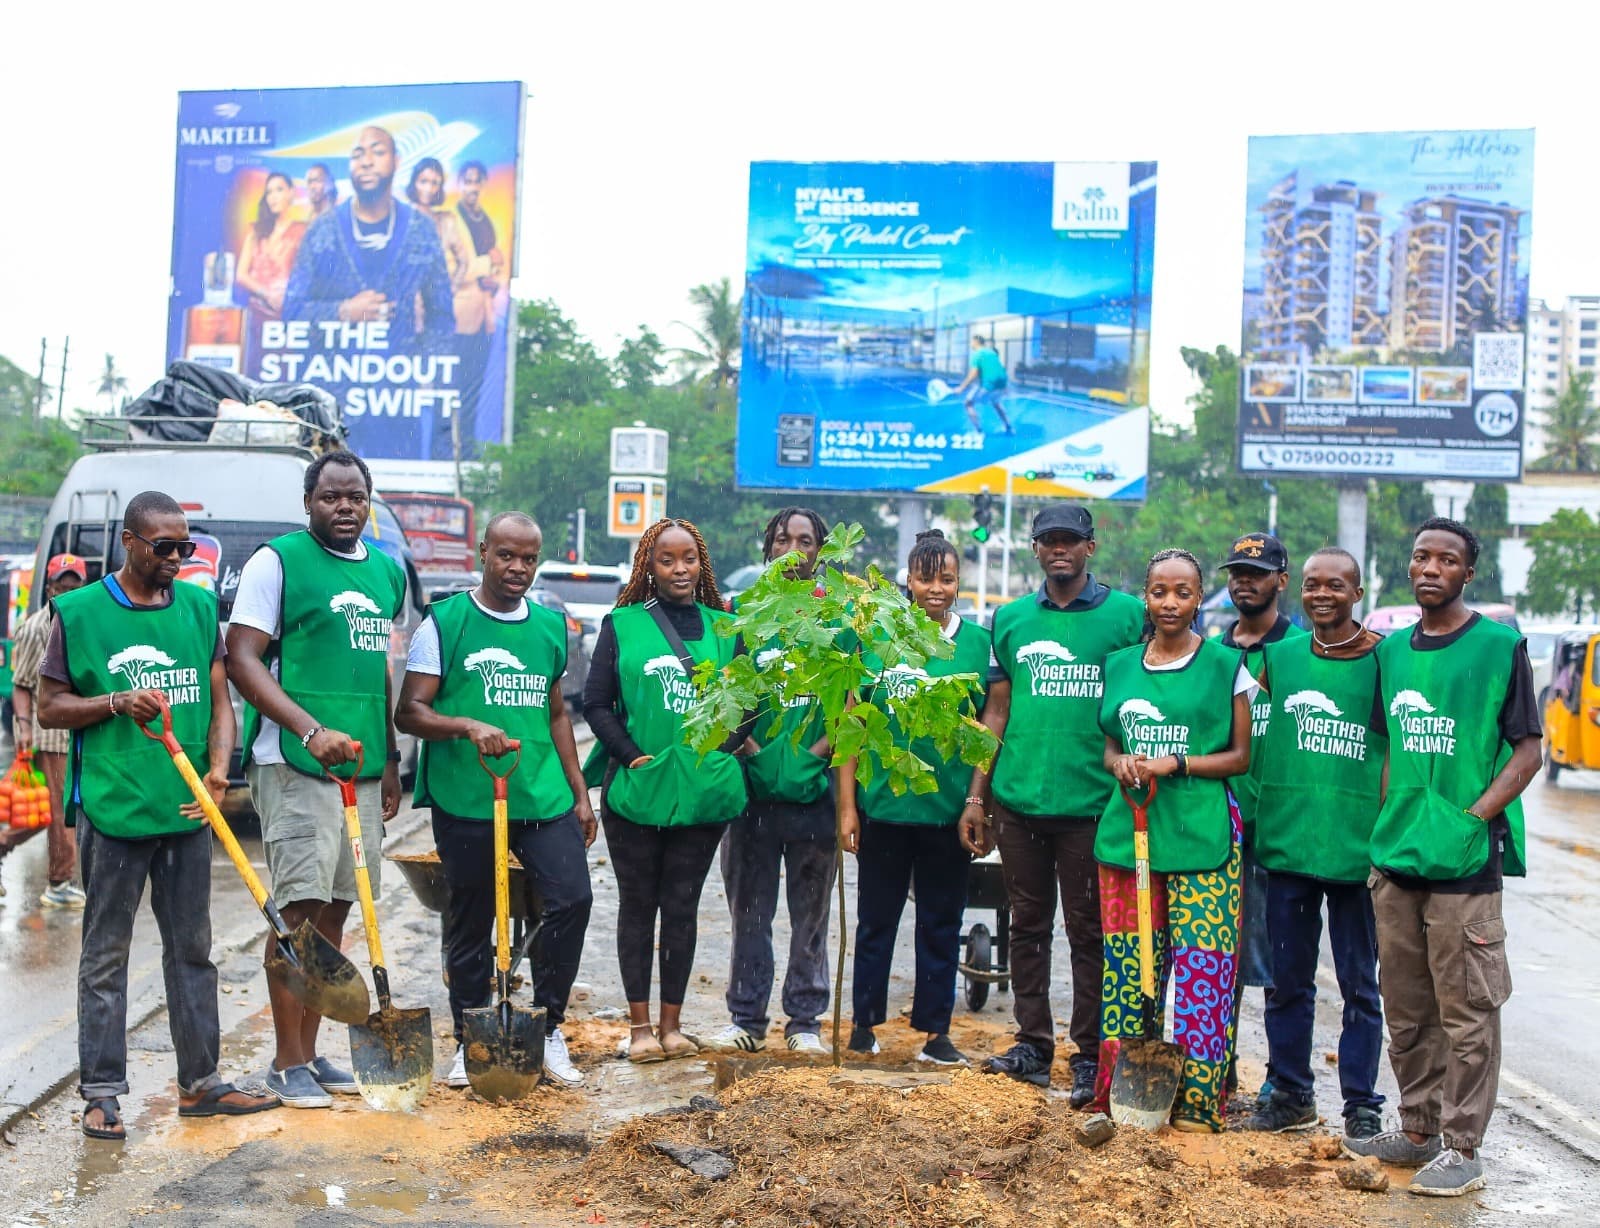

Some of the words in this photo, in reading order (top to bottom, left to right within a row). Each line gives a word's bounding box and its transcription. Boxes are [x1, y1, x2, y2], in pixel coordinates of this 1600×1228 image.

[180, 126, 271, 145] MARTELL
[795, 187, 865, 202] NYALI'S
[819, 202, 919, 216] RESIDENCE
[1063, 201, 1119, 221] Palm
[902, 224, 974, 249] Court
[261, 320, 311, 349] BE
[318, 320, 391, 350] THE
[259, 353, 461, 385] STANDOUT
[344, 387, 461, 417] SWIFT
[878, 432, 911, 447] 743
[913, 433, 947, 449] 666
[951, 433, 985, 450] 222
[1282, 449, 1395, 466] 0759000222
[493, 690, 548, 708] 4CLIMATE
[1303, 734, 1367, 761] 4CLIMATE
[1406, 735, 1457, 756] 4CLIMATE
